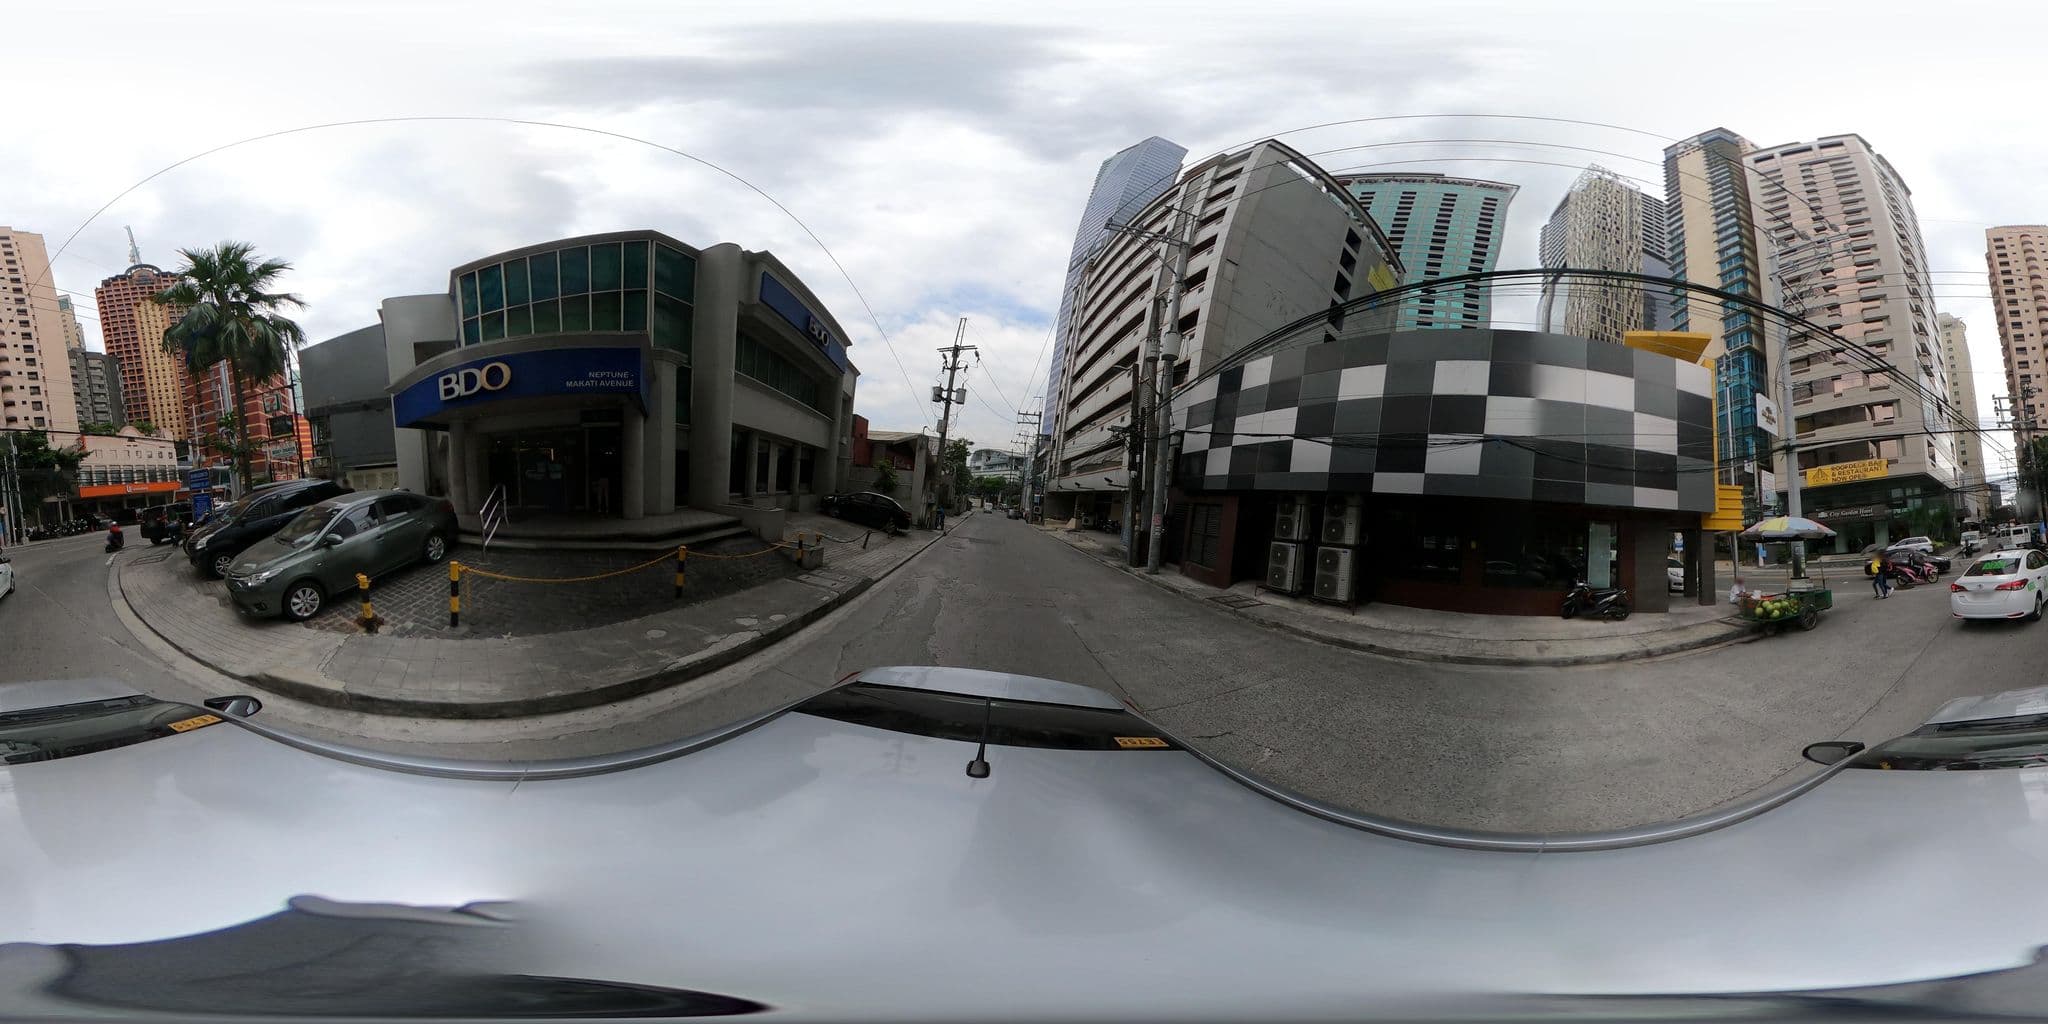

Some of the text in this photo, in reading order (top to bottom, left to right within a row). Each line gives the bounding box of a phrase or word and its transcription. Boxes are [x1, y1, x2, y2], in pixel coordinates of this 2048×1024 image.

[810, 316, 829, 346] BDO
[438, 361, 512, 401] BDO
[566, 379, 634, 388] MAKATI AVENUE
